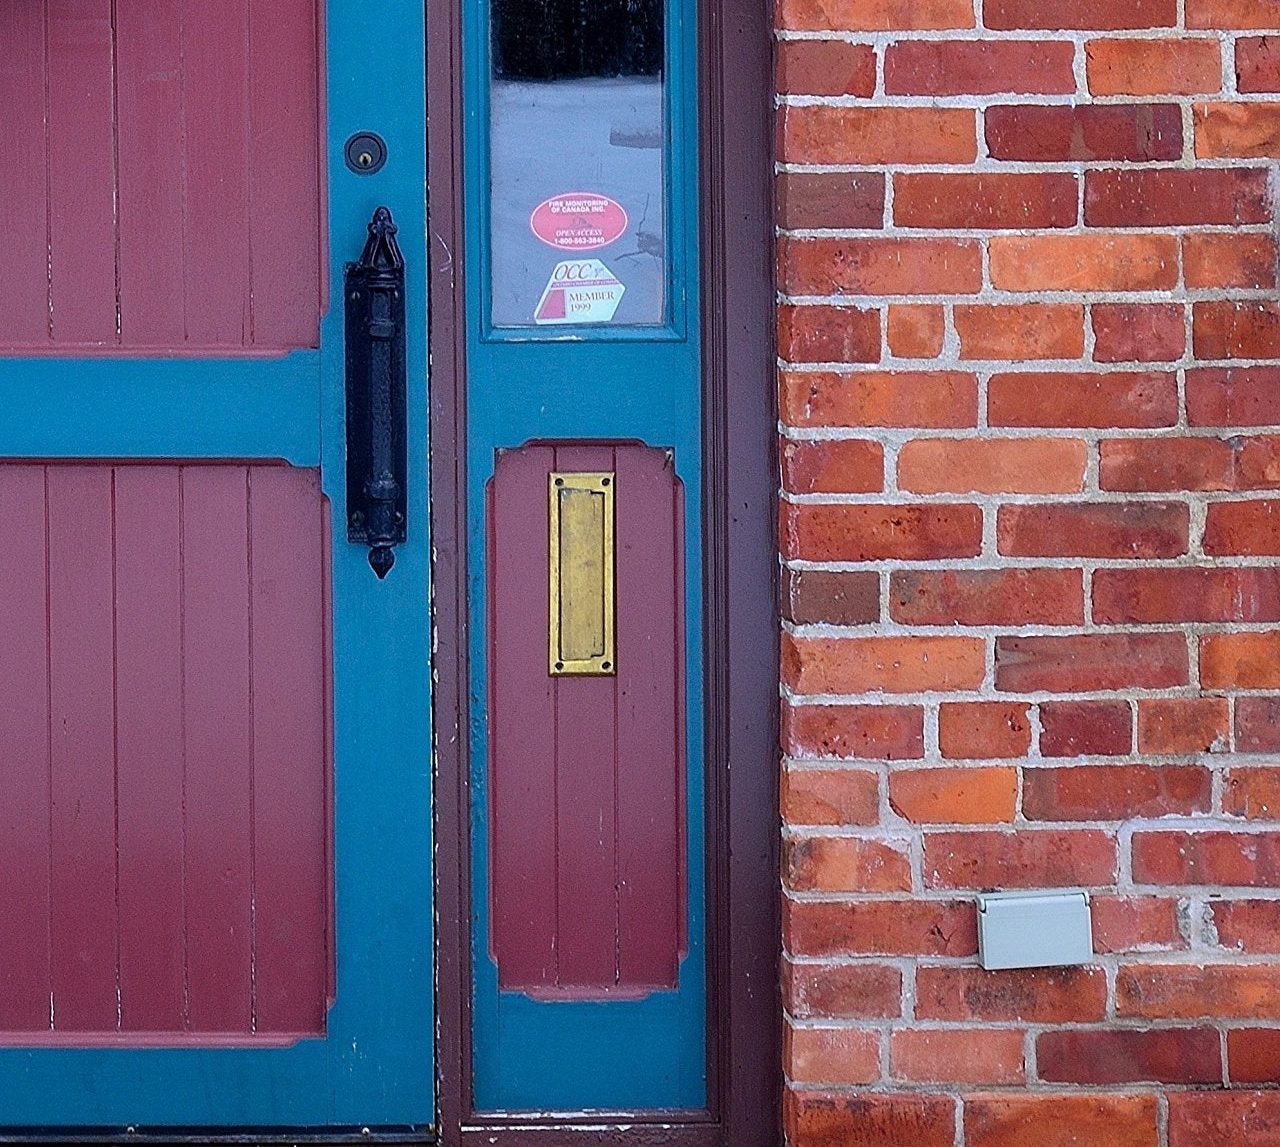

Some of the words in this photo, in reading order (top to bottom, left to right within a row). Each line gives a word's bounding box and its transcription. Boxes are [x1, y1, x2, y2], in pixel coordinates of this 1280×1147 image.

[548, 200, 564, 208] FIRE
[551, 206, 560, 214] OF
[561, 206, 590, 214] CANADA
[556, 229, 574, 237] OPEN
[554, 263, 592, 281] OCC
[569, 291, 615, 302] MEMBER
[571, 303, 591, 312] 1999
